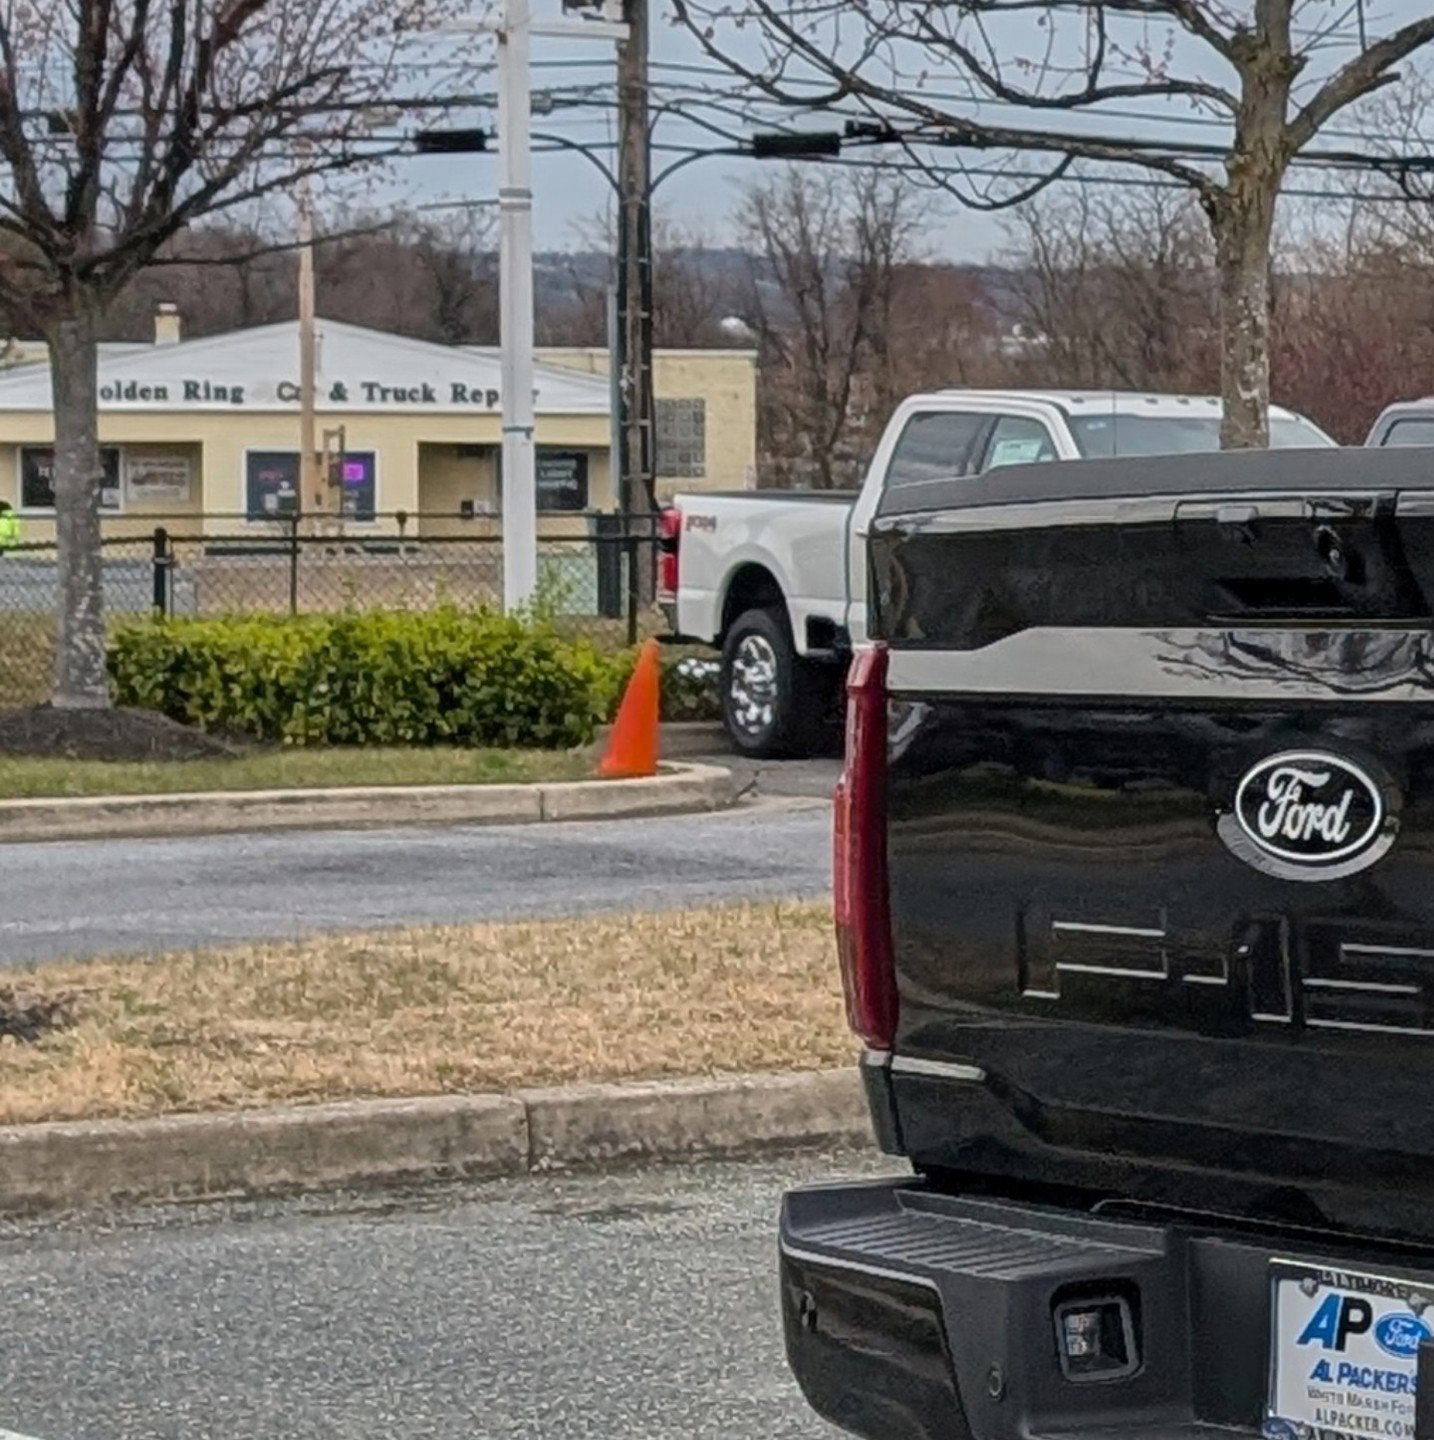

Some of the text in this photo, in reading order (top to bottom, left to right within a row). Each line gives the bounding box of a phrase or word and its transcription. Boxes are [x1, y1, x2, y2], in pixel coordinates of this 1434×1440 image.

[100, 380, 168, 401] olden
[183, 380, 244, 404] Ring
[329, 381, 348, 402] &
[361, 382, 437, 403] Truck
[1258, 767, 1354, 844] Ford
[1297, 1293, 1373, 1352] AP
[1383, 1317, 1422, 1350] Ford
[1310, 1359, 1333, 1382] AL
